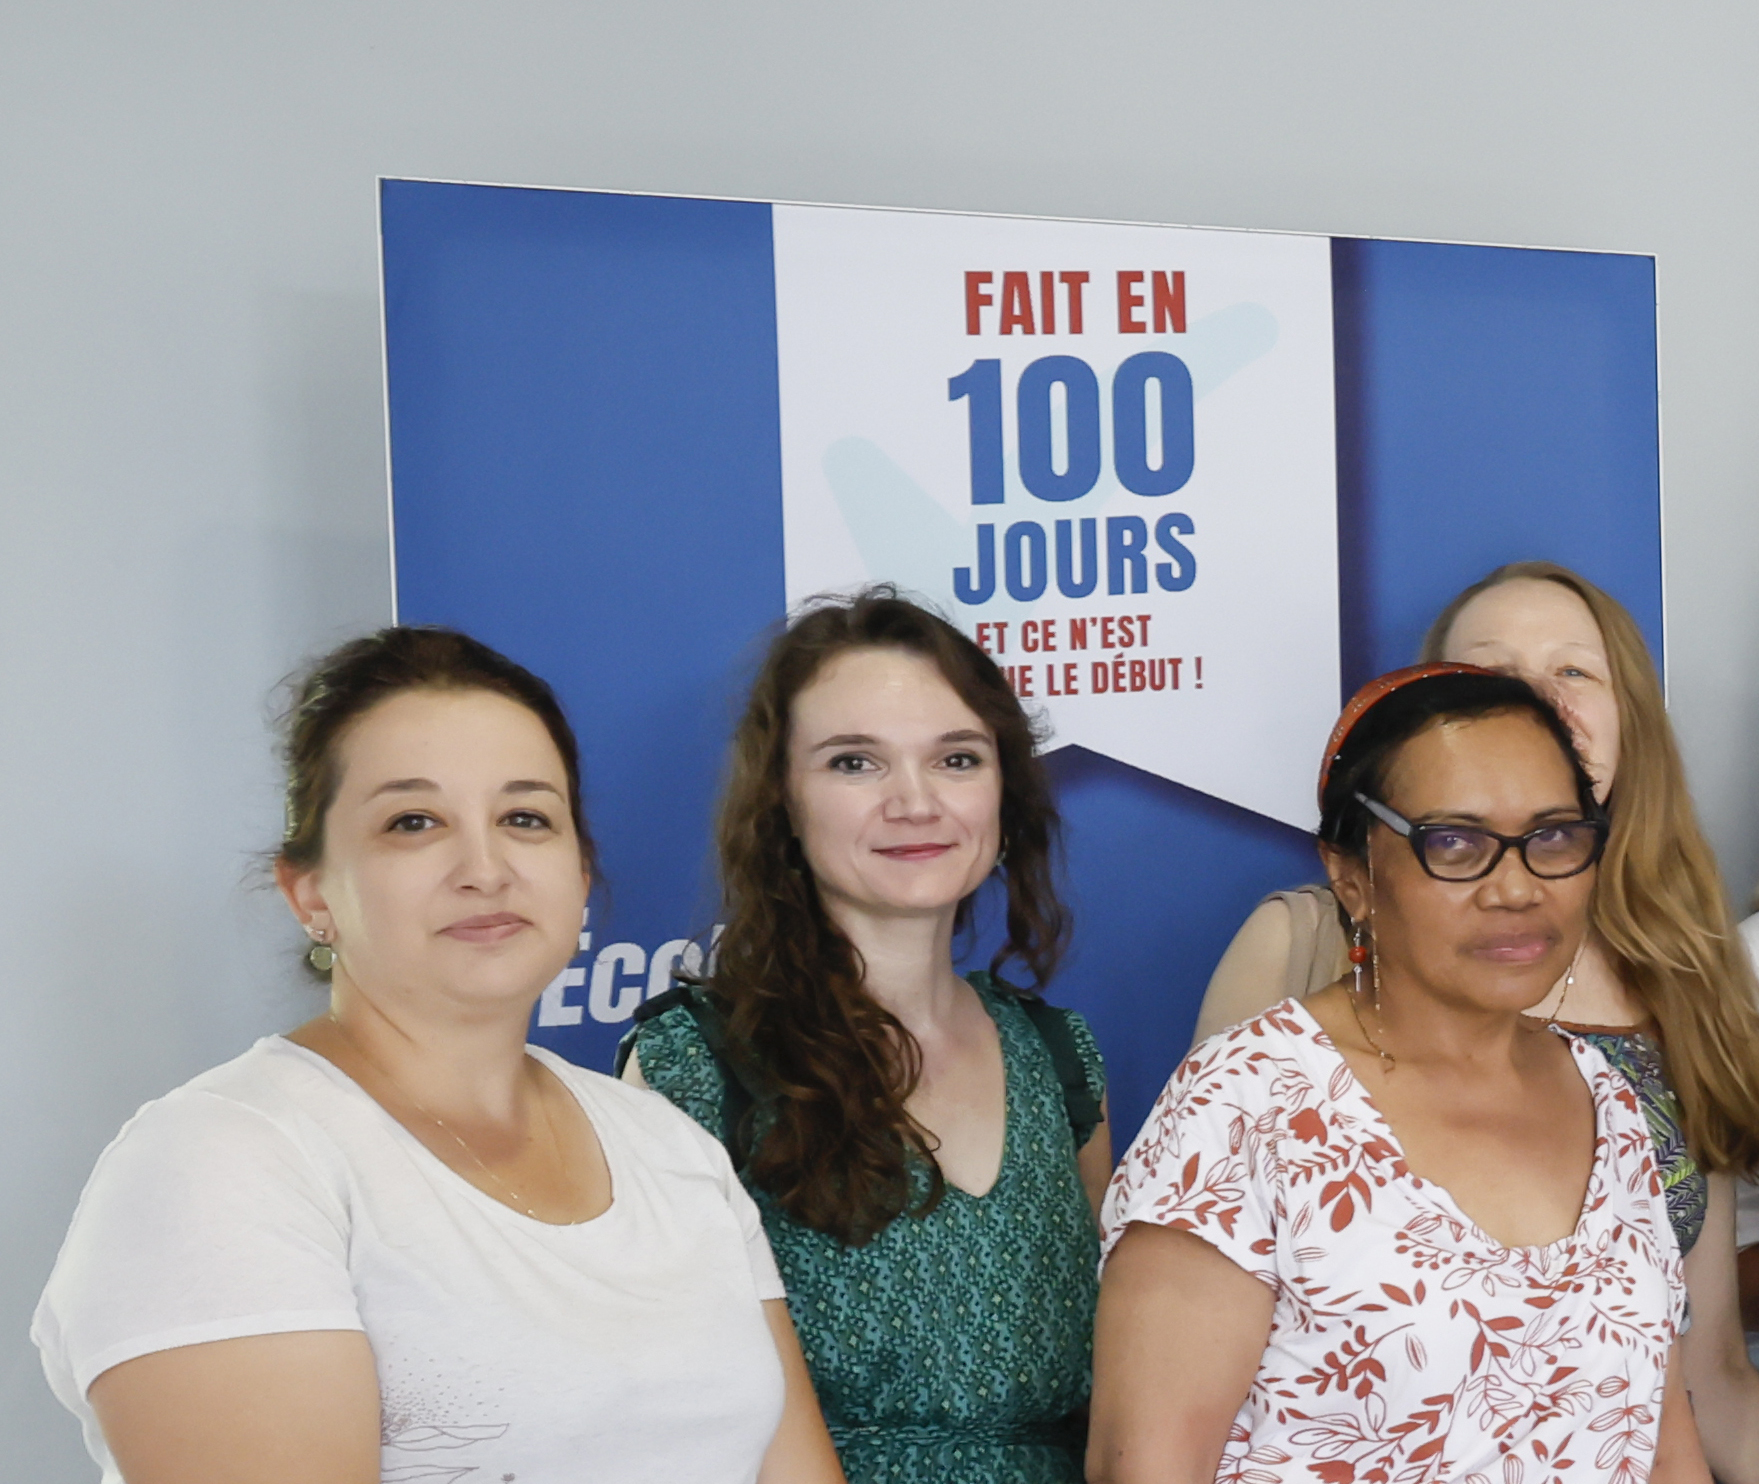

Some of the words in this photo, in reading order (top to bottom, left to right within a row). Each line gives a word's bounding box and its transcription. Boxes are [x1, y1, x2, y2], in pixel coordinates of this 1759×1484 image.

[964, 270, 1090, 336] FAIT
[1116, 270, 1187, 334] EN
[947, 350, 1195, 506] 100
[952, 512, 1197, 606] JOURS
[976, 621, 1009, 655] ET
[1021, 619, 1057, 653] CE
[1069, 614, 1152, 651] N’EST
[1046, 662, 1079, 697] LE
[1091, 652, 1183, 695] DÉBUT
[1194, 655, 1204, 690] !
